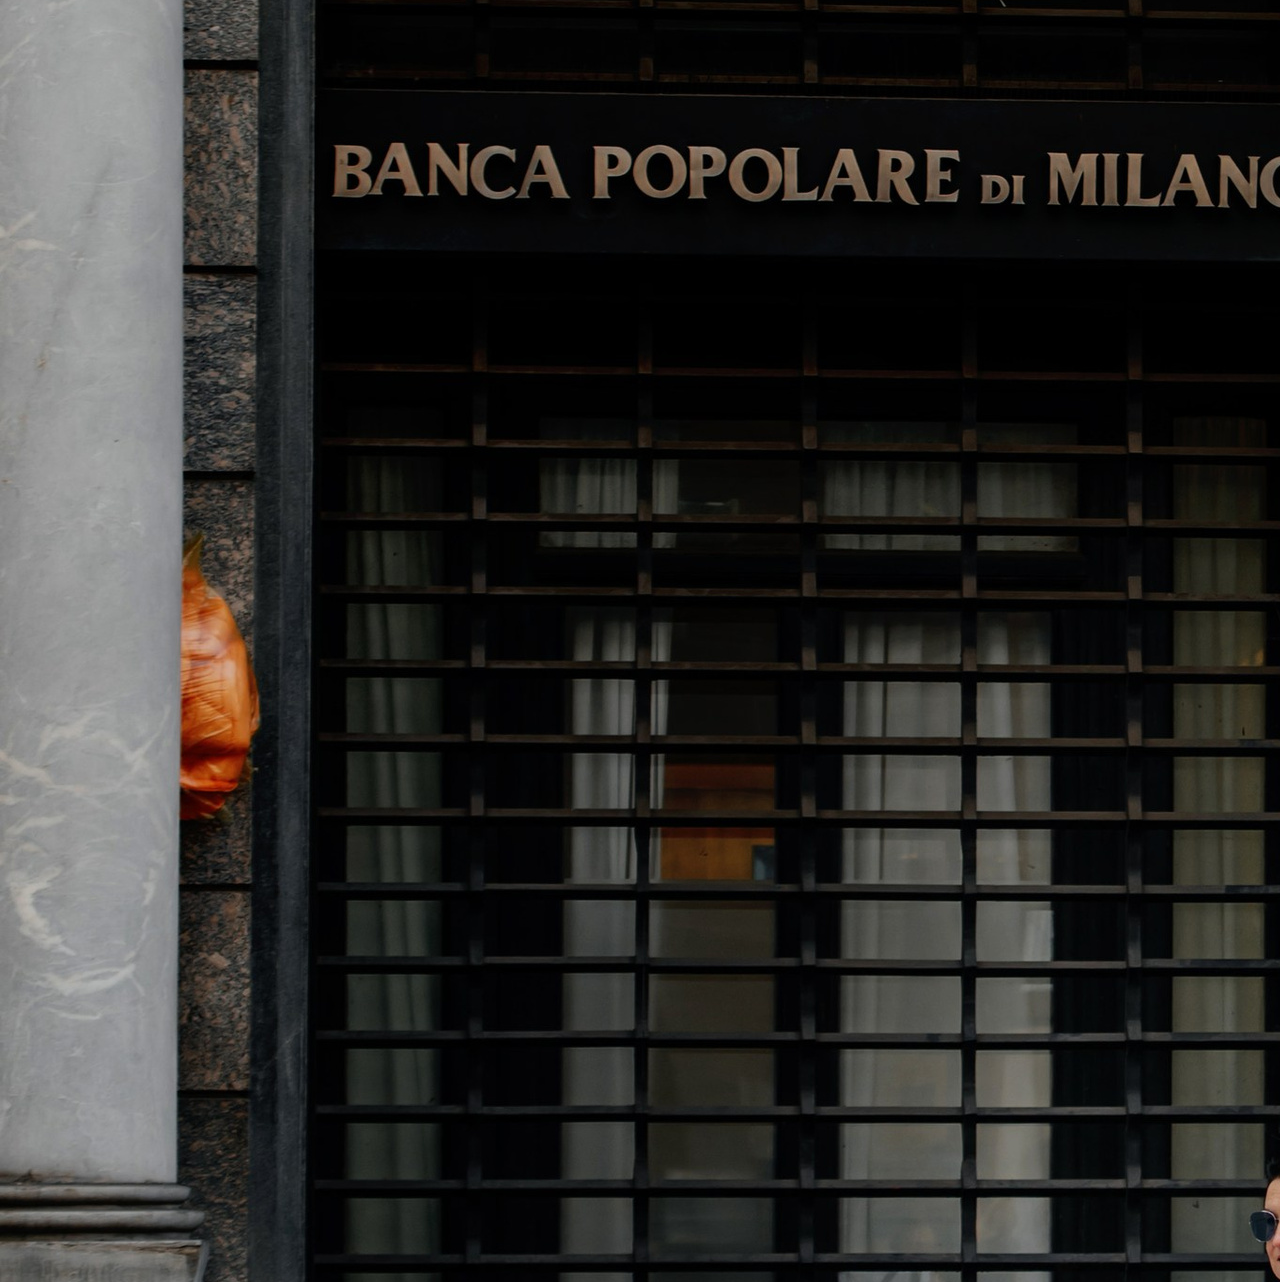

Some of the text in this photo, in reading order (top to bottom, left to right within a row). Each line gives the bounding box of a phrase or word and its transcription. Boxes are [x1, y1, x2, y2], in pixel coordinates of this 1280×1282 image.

[331, 142, 571, 200] BANCA
[592, 144, 961, 206] POPOLARE
[980, 174, 1026, 205] DI
